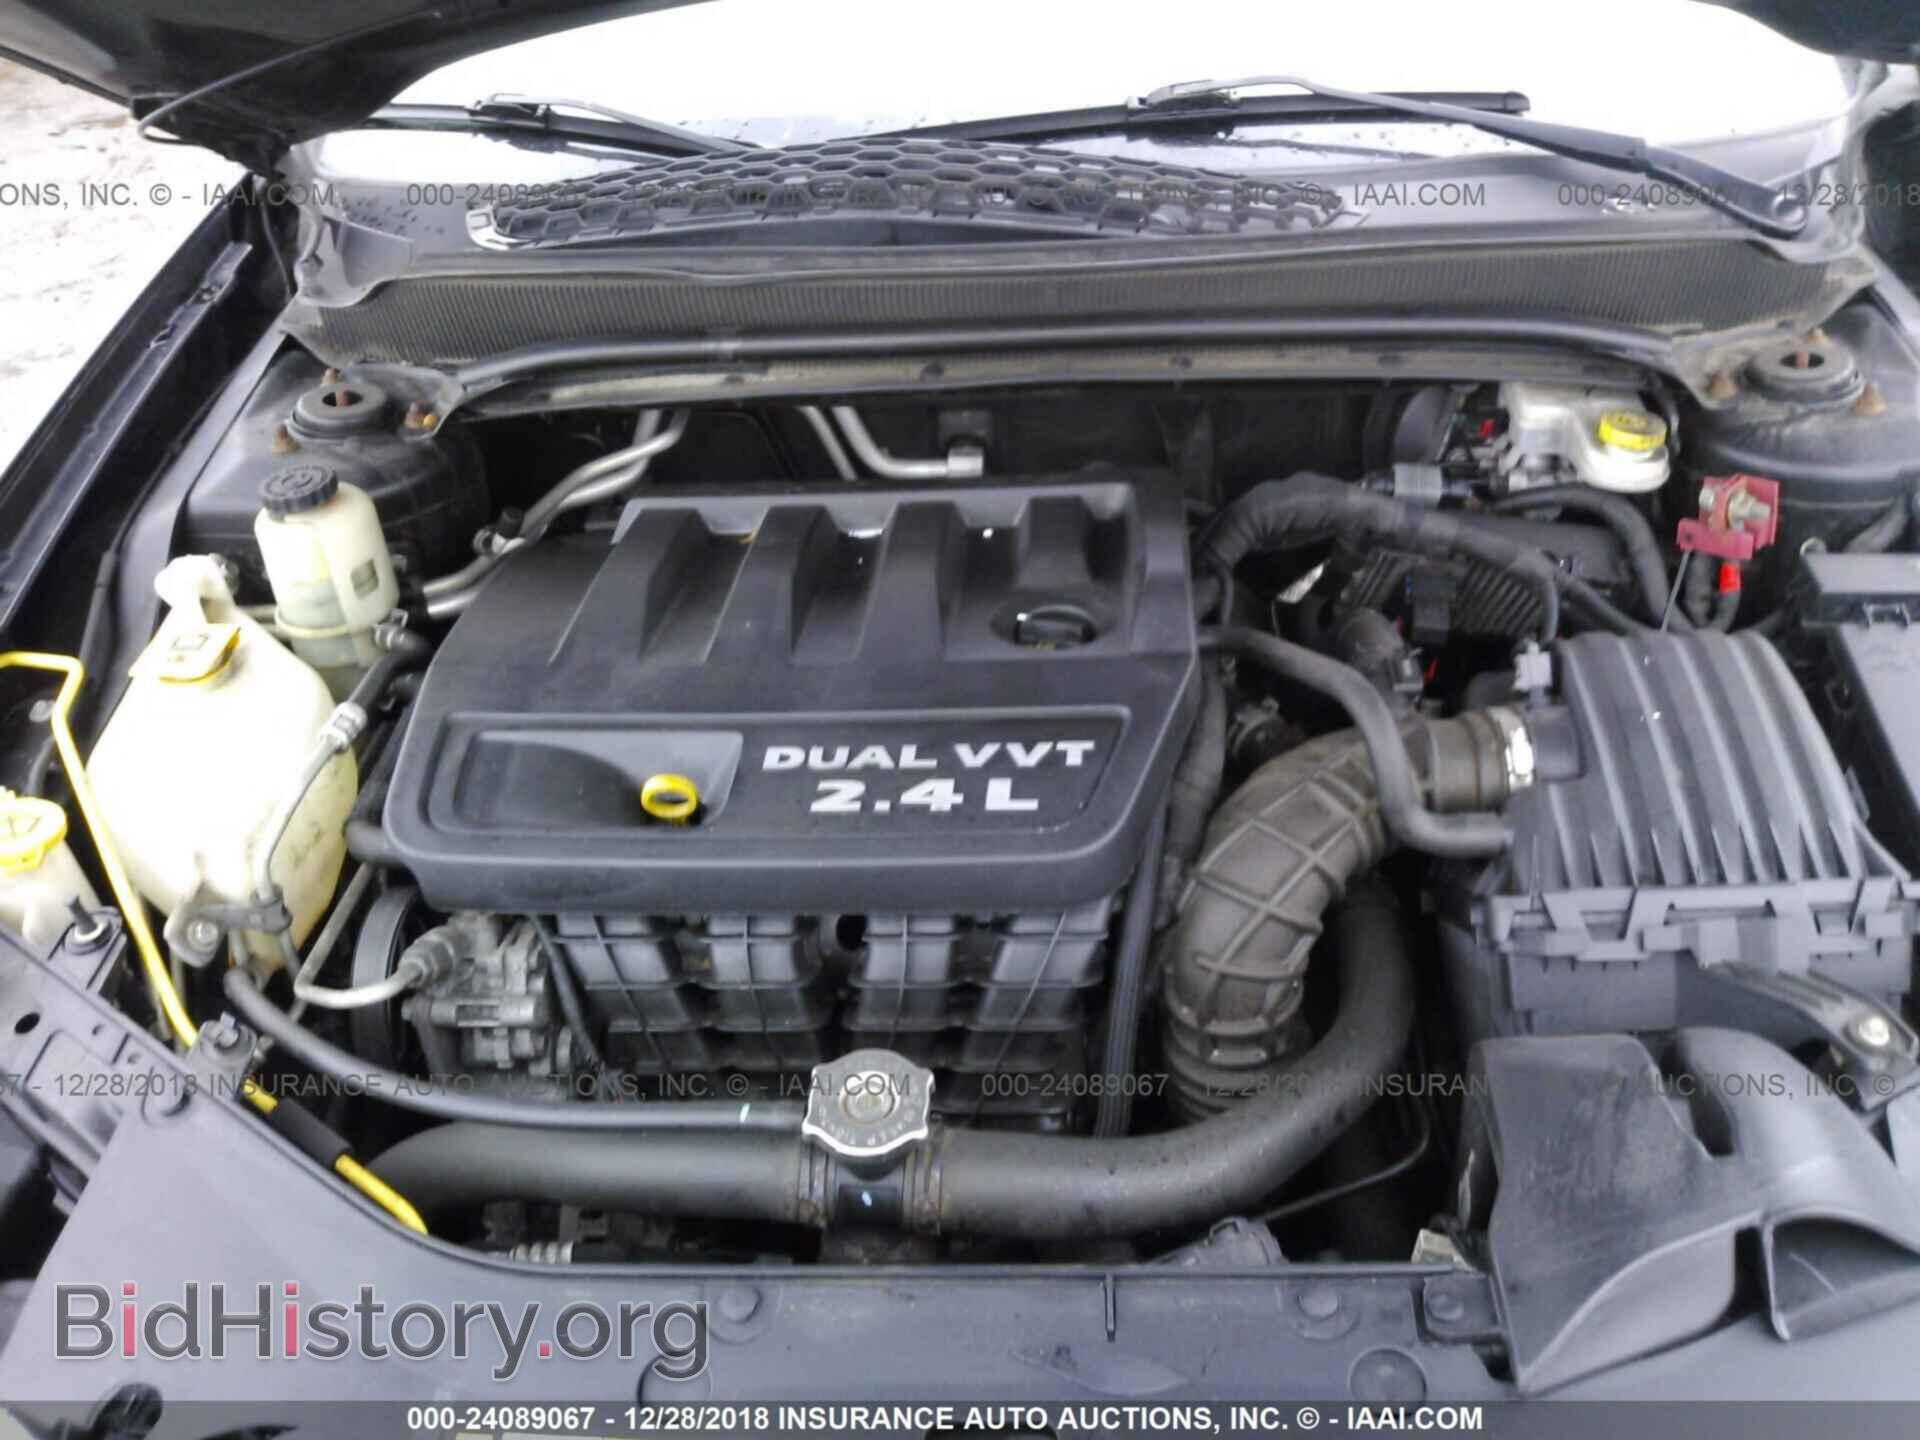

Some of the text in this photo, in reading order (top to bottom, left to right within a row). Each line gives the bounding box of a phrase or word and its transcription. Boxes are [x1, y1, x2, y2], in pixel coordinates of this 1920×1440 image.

[763, 740, 1095, 771] DUAL VVT
[810, 777, 1039, 812] 2.4 L
